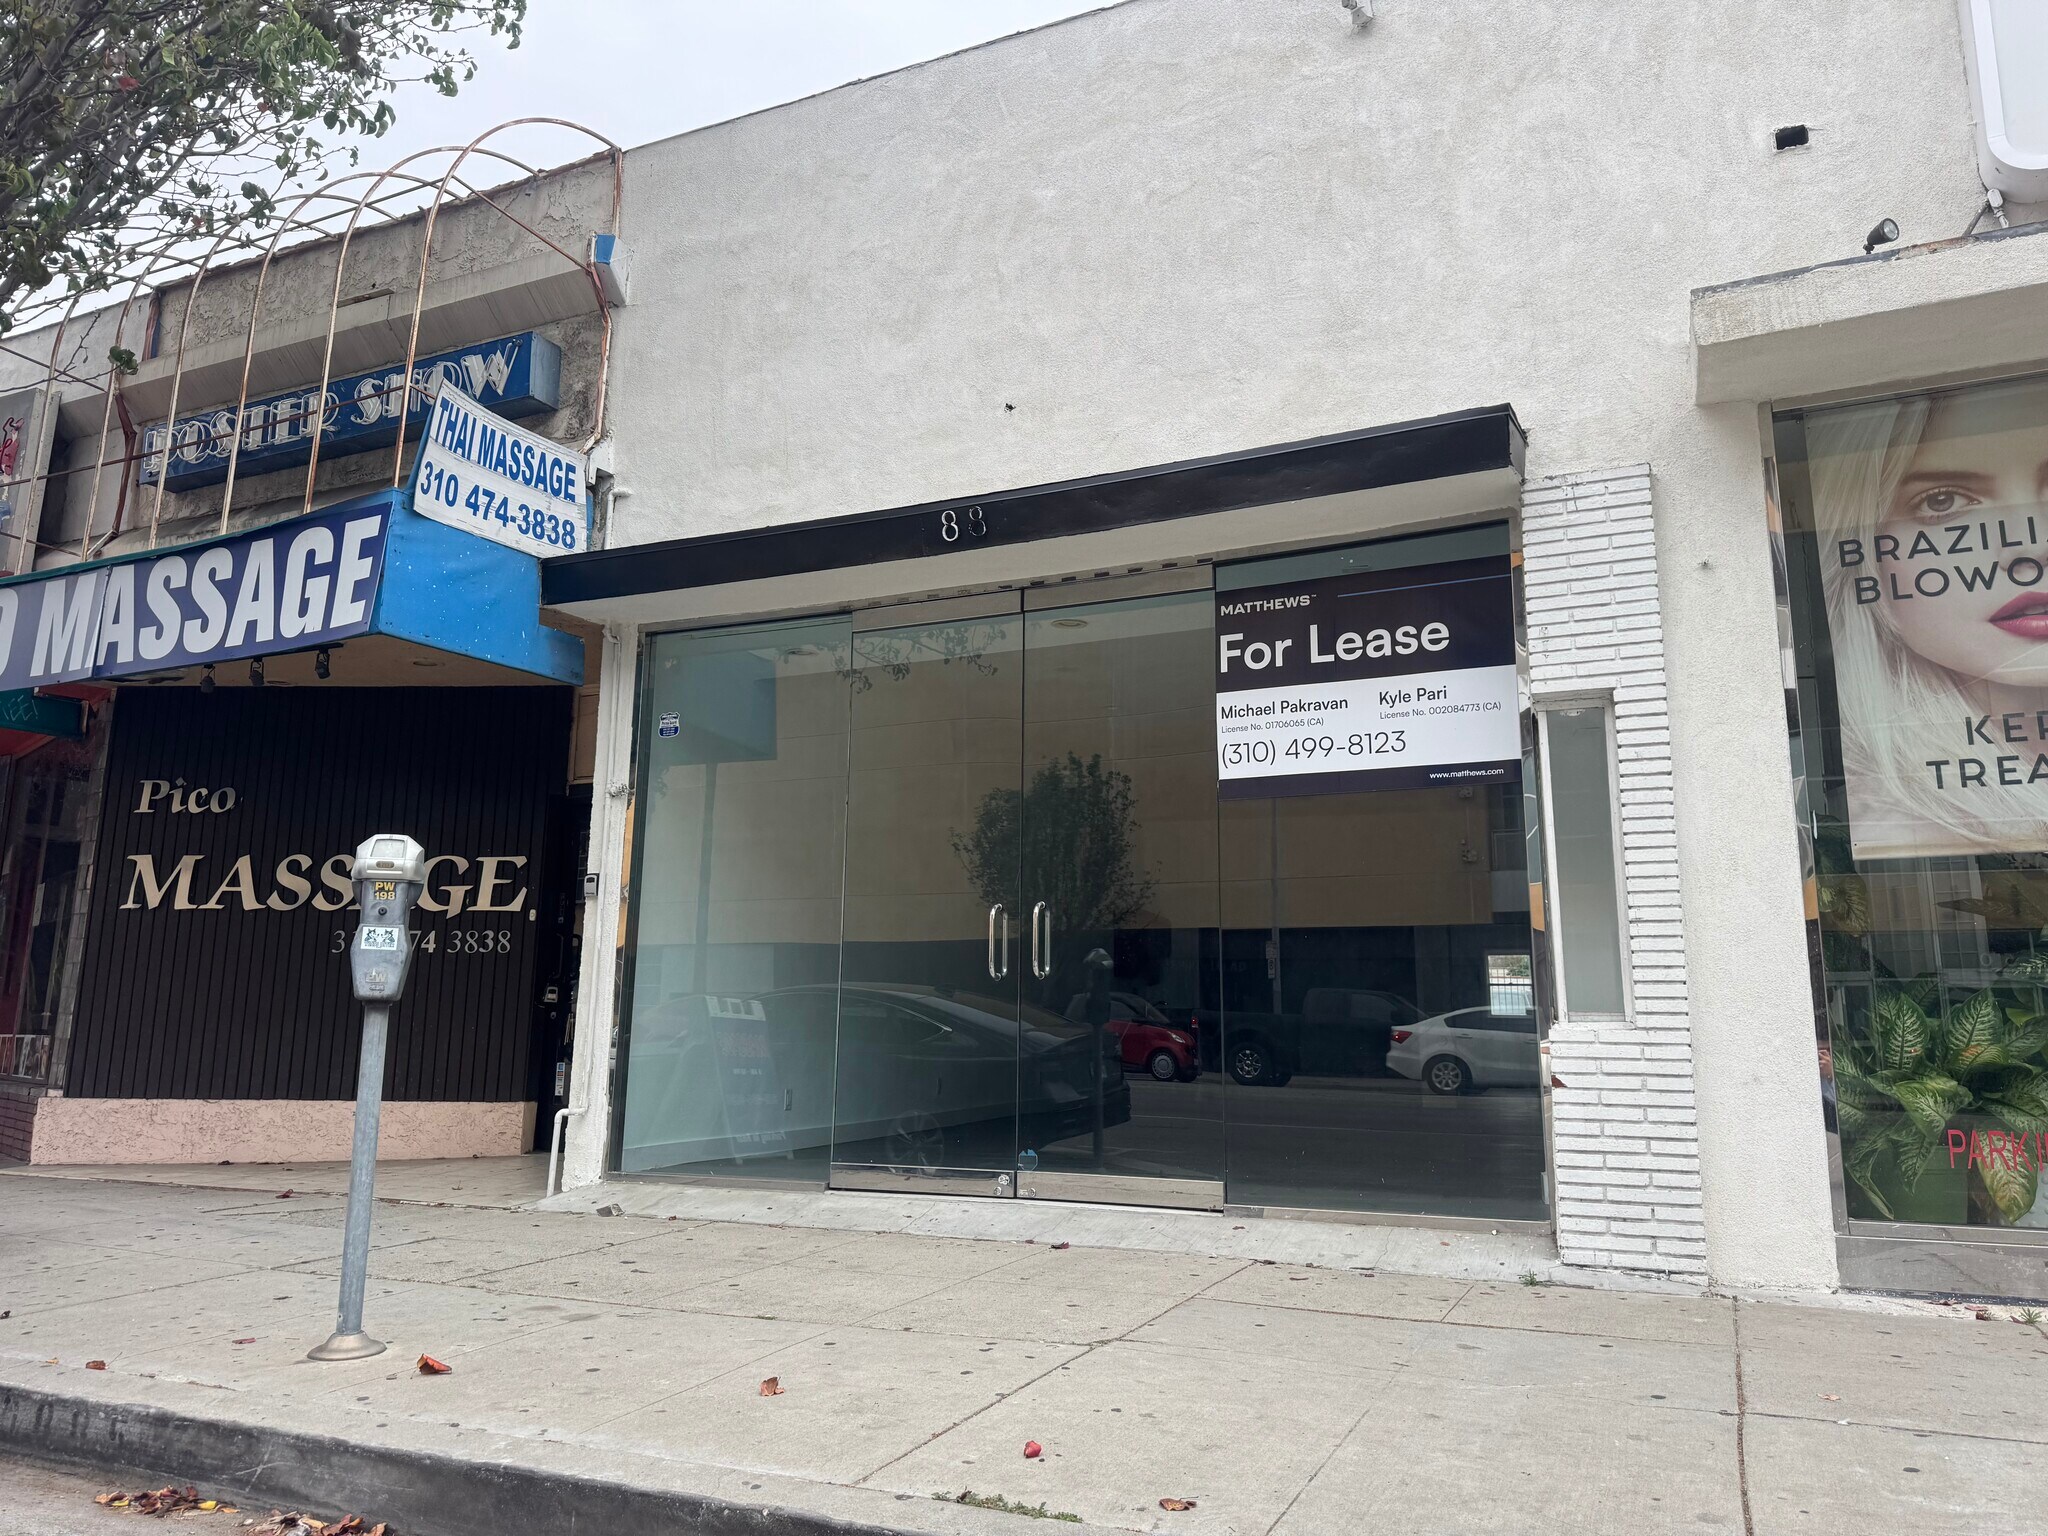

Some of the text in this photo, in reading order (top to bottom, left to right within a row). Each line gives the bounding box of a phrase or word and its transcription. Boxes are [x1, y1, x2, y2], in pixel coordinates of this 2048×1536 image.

[351, 338, 523, 426] SHOW
[435, 396, 577, 503] THAI MASSAGE
[420, 461, 576, 549] 310 474-3838
[1838, 516, 2048, 568] BRAZILI
[30, 514, 381, 677] MASSAGE
[1219, 621, 1450, 673] For Lease
[1221, 698, 1349, 719] Michael Pakravan
[1379, 685, 1448, 706] Kyle Pari
[1379, 701, 1502, 720] License No. 002084773 (CA)
[1221, 717, 1324, 734] License No. 01706065 (CA)
[1222, 730, 1407, 769] (310) 499-8123
[1430, 767, 1504, 779] www.matthews.com
[134, 777, 236, 814] Pico
[119, 853, 528, 919] MASSGE
[375, 882, 395, 891] PW
[375, 891, 396, 901] 198
[409, 930, 511, 953] 74 3838
